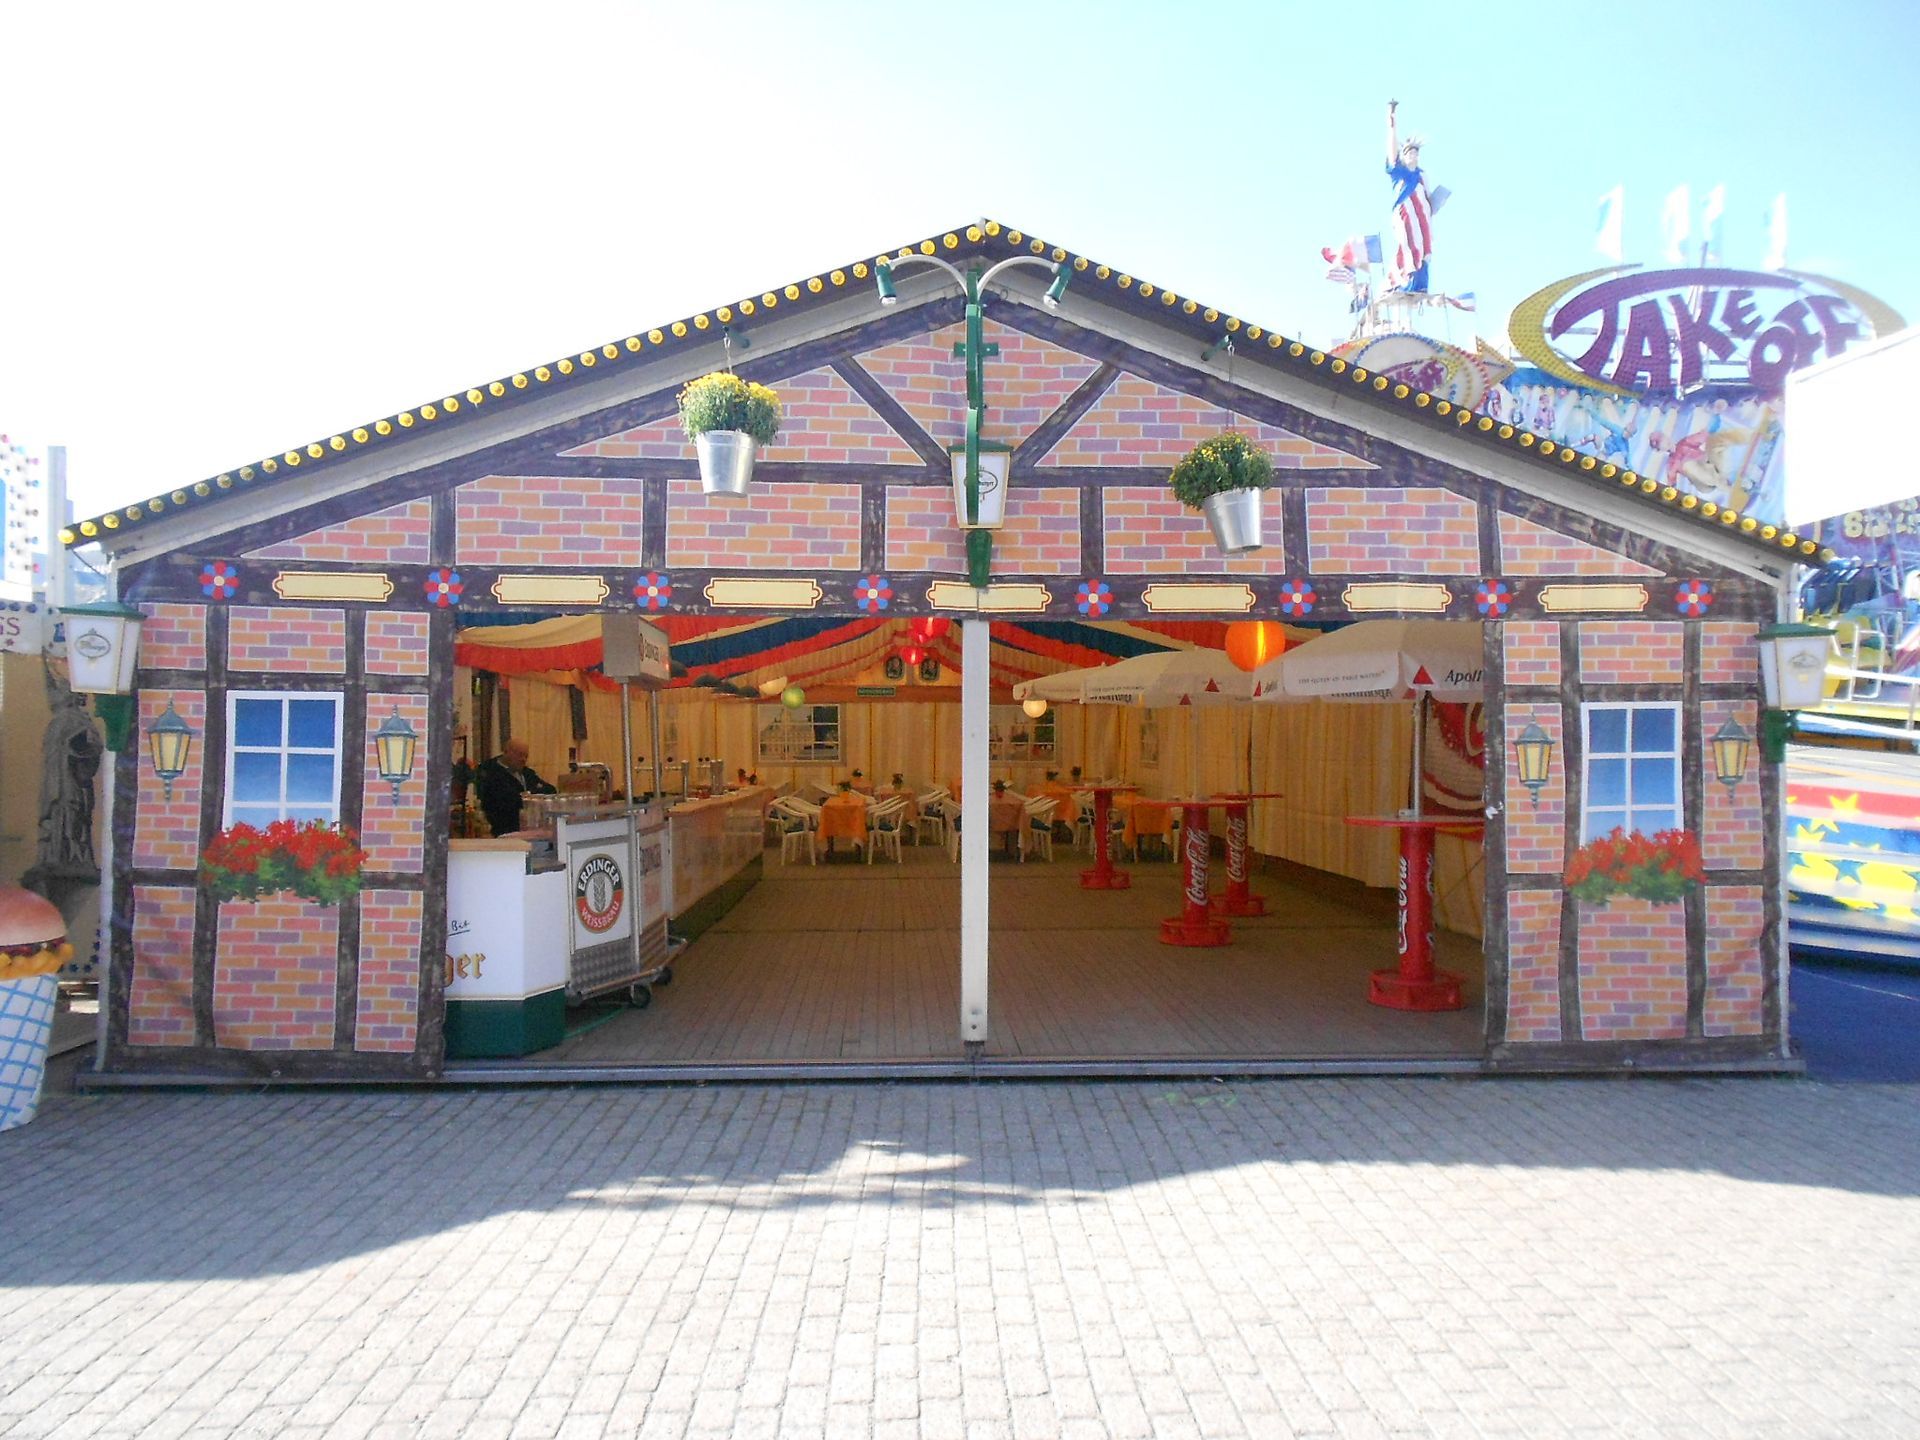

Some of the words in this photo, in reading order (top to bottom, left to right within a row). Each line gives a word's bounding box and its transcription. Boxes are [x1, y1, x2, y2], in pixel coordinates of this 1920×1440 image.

[1551, 267, 1803, 390] TAKE
[1748, 294, 1861, 387] OFF
[578, 857, 620, 891] ERDINGER
